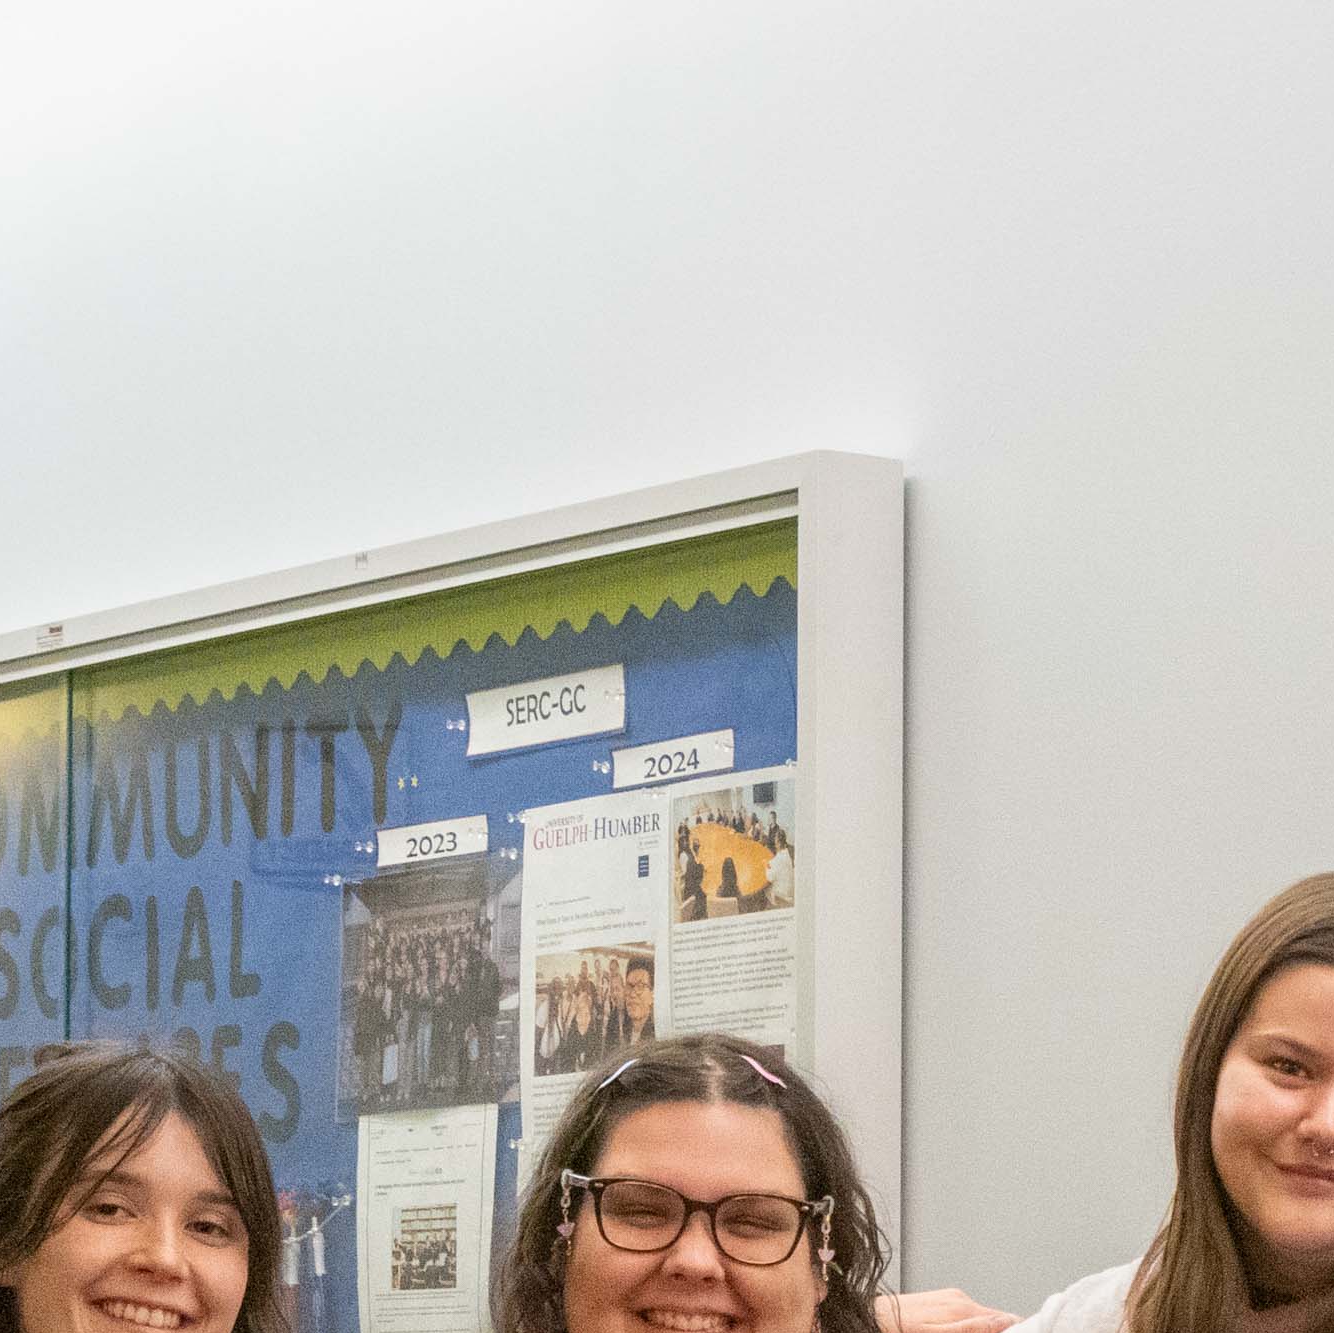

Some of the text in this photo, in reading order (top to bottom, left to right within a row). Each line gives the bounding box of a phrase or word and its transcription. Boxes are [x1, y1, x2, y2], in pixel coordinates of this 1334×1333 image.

[506, 684, 586, 727] SERC-GC
[643, 748, 700, 779] 2024
[406, 831, 457, 858] 2023
